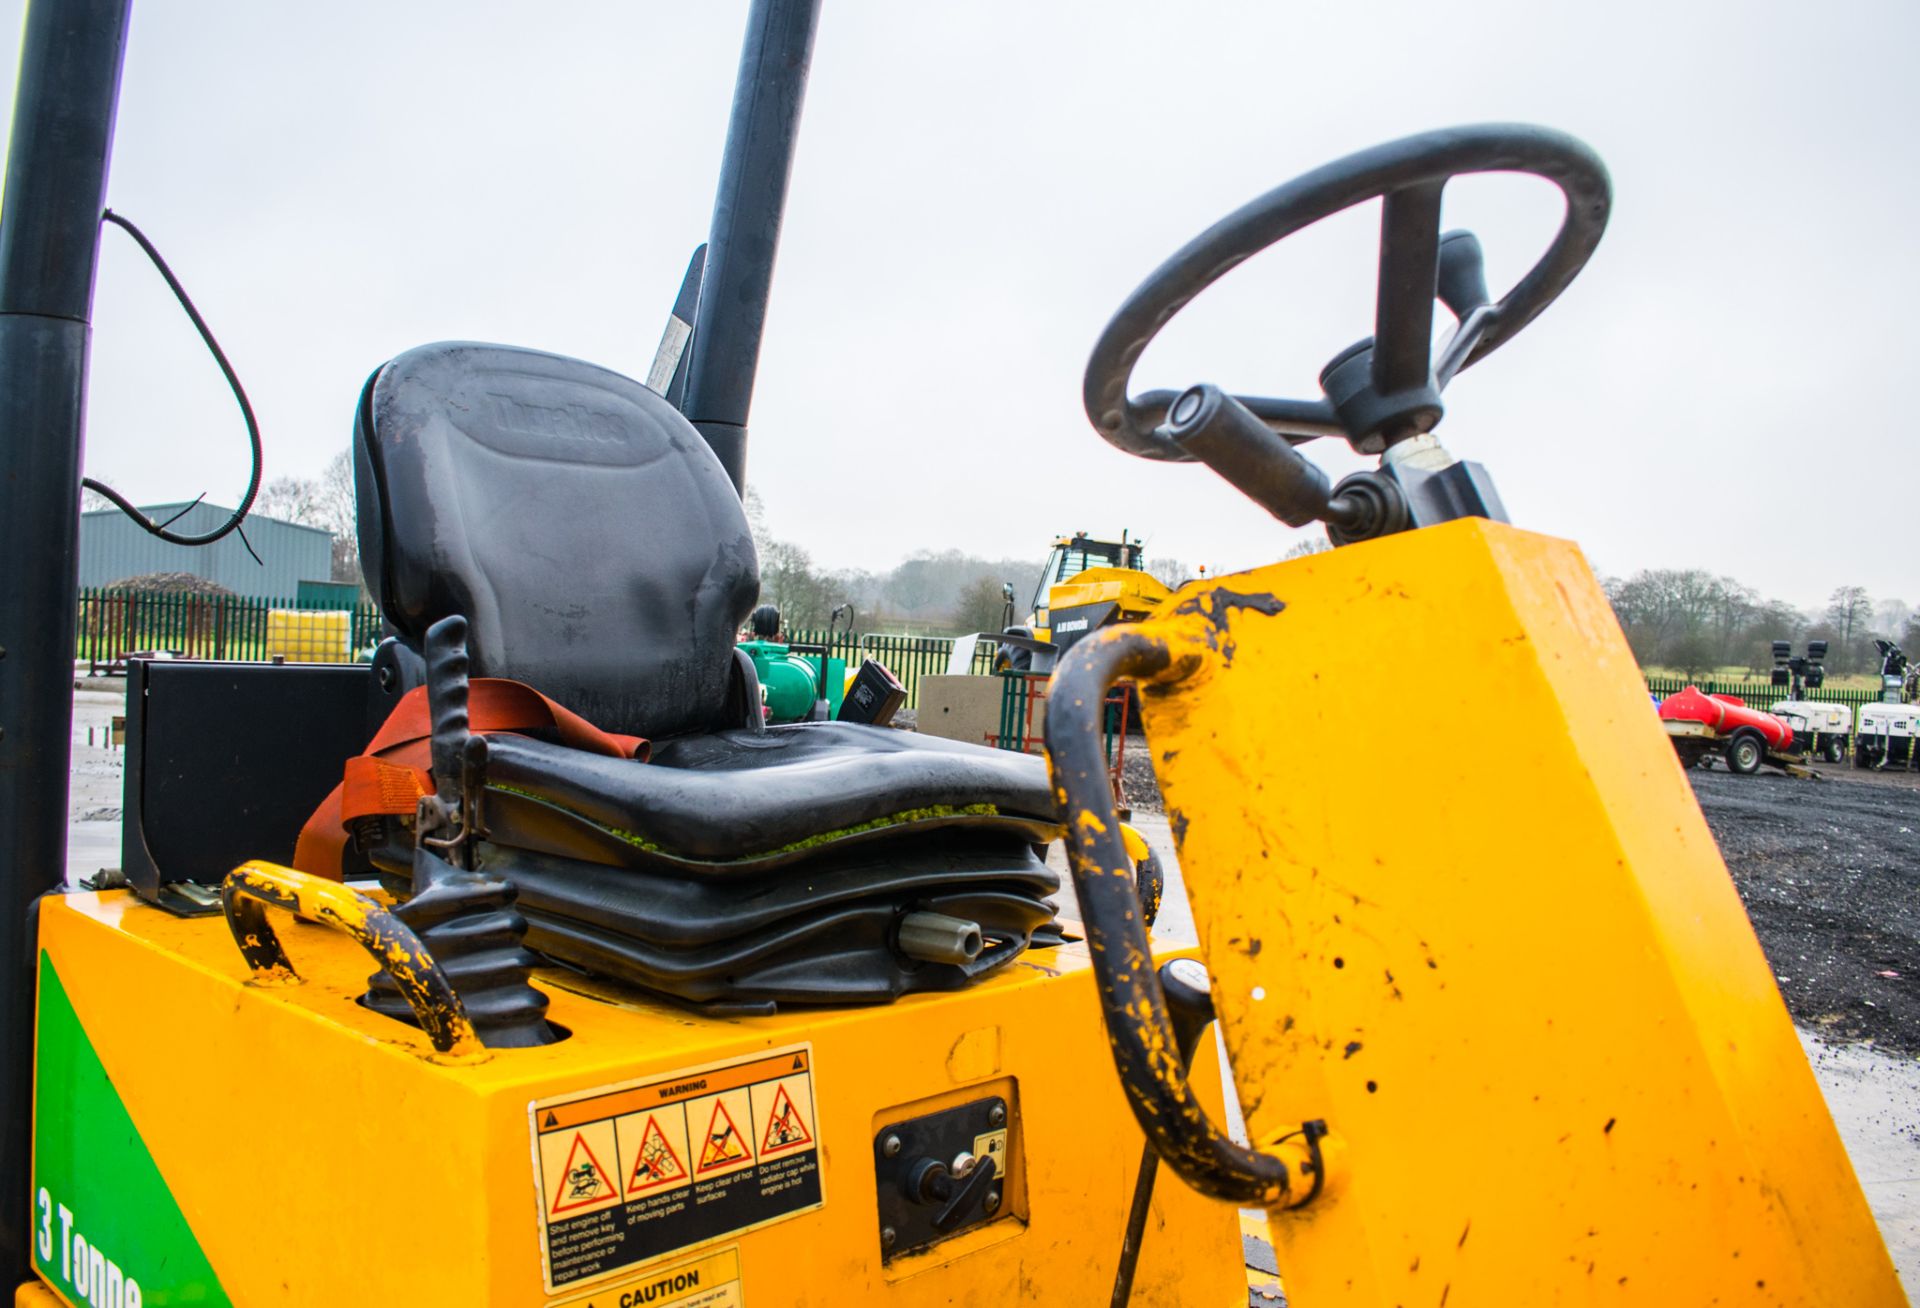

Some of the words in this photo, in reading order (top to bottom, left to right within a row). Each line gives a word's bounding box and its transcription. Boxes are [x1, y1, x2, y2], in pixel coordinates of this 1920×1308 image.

[659, 1080, 707, 1098] WARNING
[759, 1166, 769, 1175] Do
[770, 1162, 781, 1170] not
[782, 1156, 806, 1167] remove
[760, 1172, 785, 1185] radiator
[786, 1168, 799, 1177] cap
[799, 1163, 816, 1173] while
[695, 1183, 714, 1193] Keep
[715, 1178, 732, 1188] clear
[733, 1174, 741, 1183] of
[741, 1170, 753, 1180] hot
[761, 1183, 784, 1196] engine
[791, 1177, 803, 1186] hot
[626, 1202, 647, 1213] Keep
[647, 1195, 671, 1207] hands
[671, 1190, 690, 1200] clear
[696, 1190, 727, 1205] surfaces
[38, 1186, 52, 1262] 3
[550, 1223, 569, 1235] Shut
[570, 1215, 599, 1229] engine
[600, 1210, 611, 1220] off
[627, 1215, 636, 1225] of
[636, 1208, 666, 1222] moving
[666, 1202, 685, 1215] parts
[551, 1235, 567, 1247] and
[568, 1227, 599, 1241] remove
[600, 1222, 615, 1233] key
[552, 1245, 579, 1258] before
[580, 1232, 625, 1252] performing
[553, 1249, 606, 1270] maintenance
[606, 1246, 616, 1254] or
[554, 1268, 578, 1282] repair
[580, 1262, 600, 1273] work
[619, 1270, 699, 1308] CAUTION
